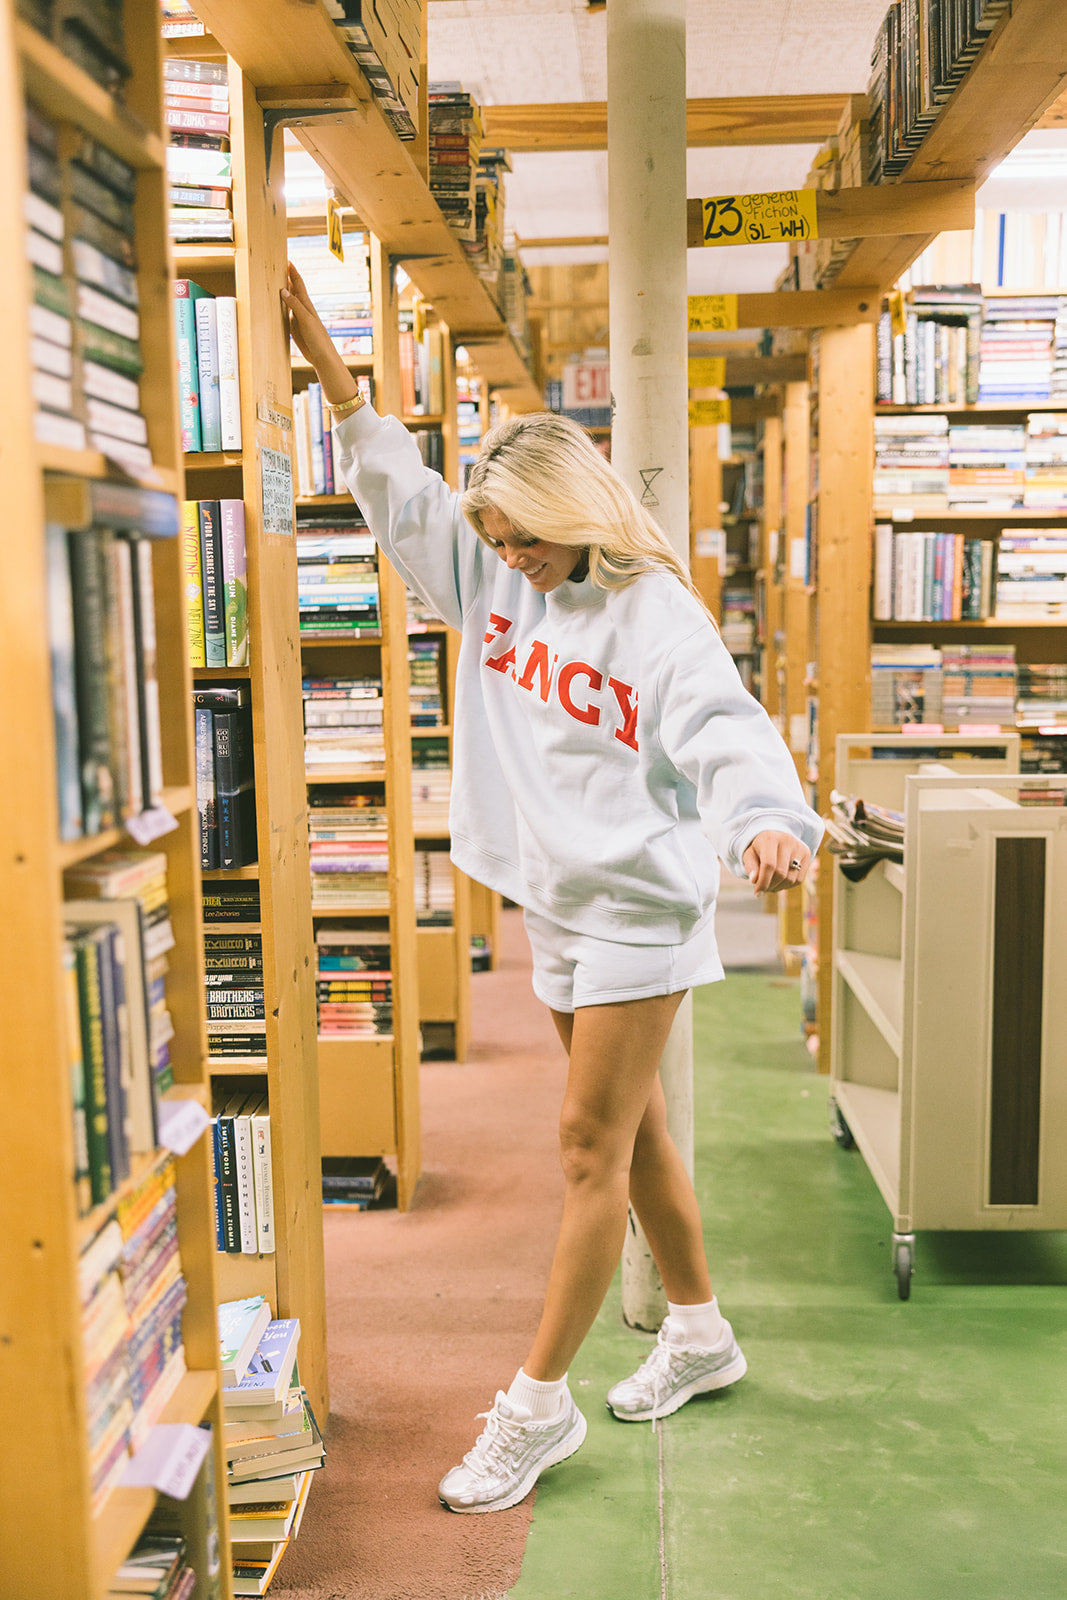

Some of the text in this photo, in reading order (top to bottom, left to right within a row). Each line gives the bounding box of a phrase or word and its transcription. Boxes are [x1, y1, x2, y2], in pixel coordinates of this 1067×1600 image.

[704, 190, 799, 240] 23 general
[199, 305, 211, 378] SHELTER
[226, 508, 234, 526] THE
[184, 526, 199, 578] NICOTINE
[205, 540, 215, 575] TREASURES
[226, 529, 236, 580] ALL-NIGHT
[228, 580, 236, 598] SUN
[209, 990, 254, 1003] BROTHERS
[210, 1005, 255, 1018] BROTHERS
